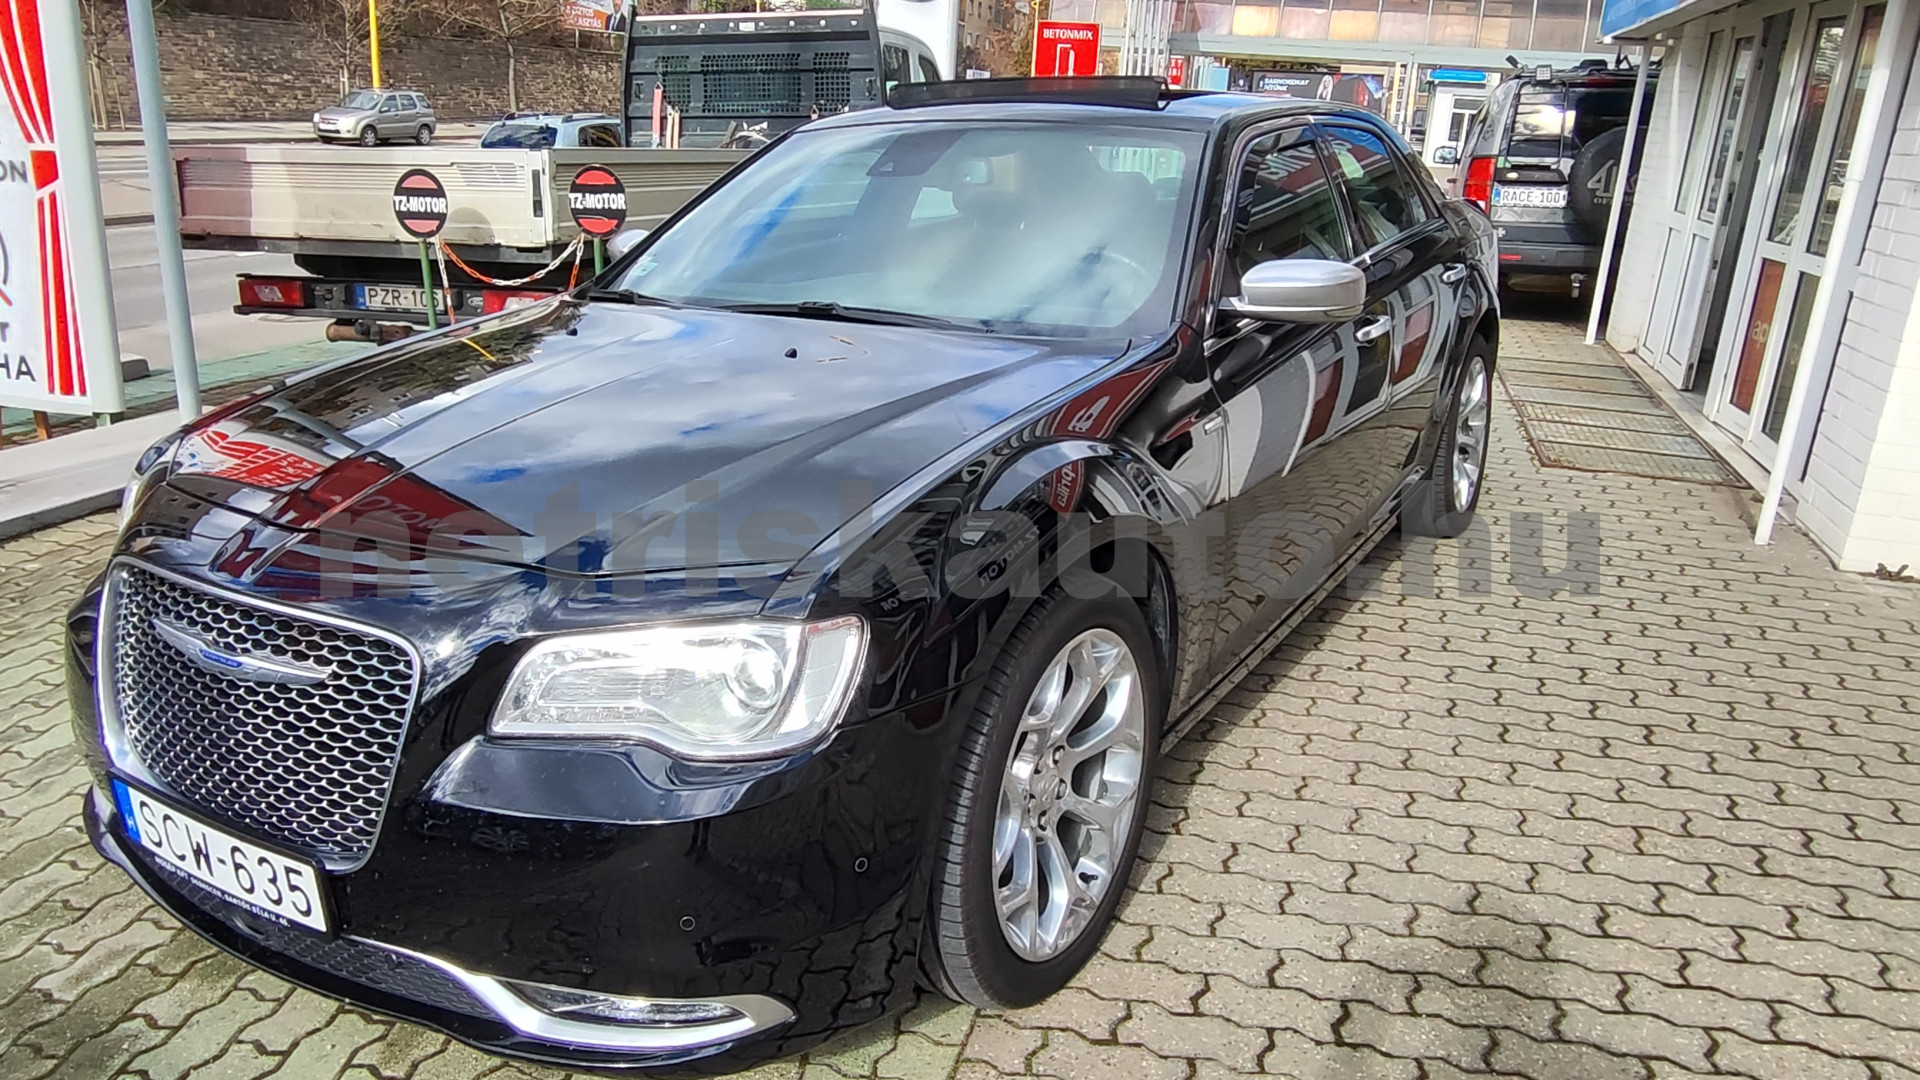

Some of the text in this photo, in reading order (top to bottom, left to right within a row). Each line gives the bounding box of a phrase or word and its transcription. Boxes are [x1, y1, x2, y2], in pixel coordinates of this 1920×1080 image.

[1043, 28, 1093, 40] BETONMIX
[393, 195, 448, 214] TZ-MOTOR
[568, 192, 626, 210] TZ-MOTOR
[139, 799, 312, 918] SCW-635
